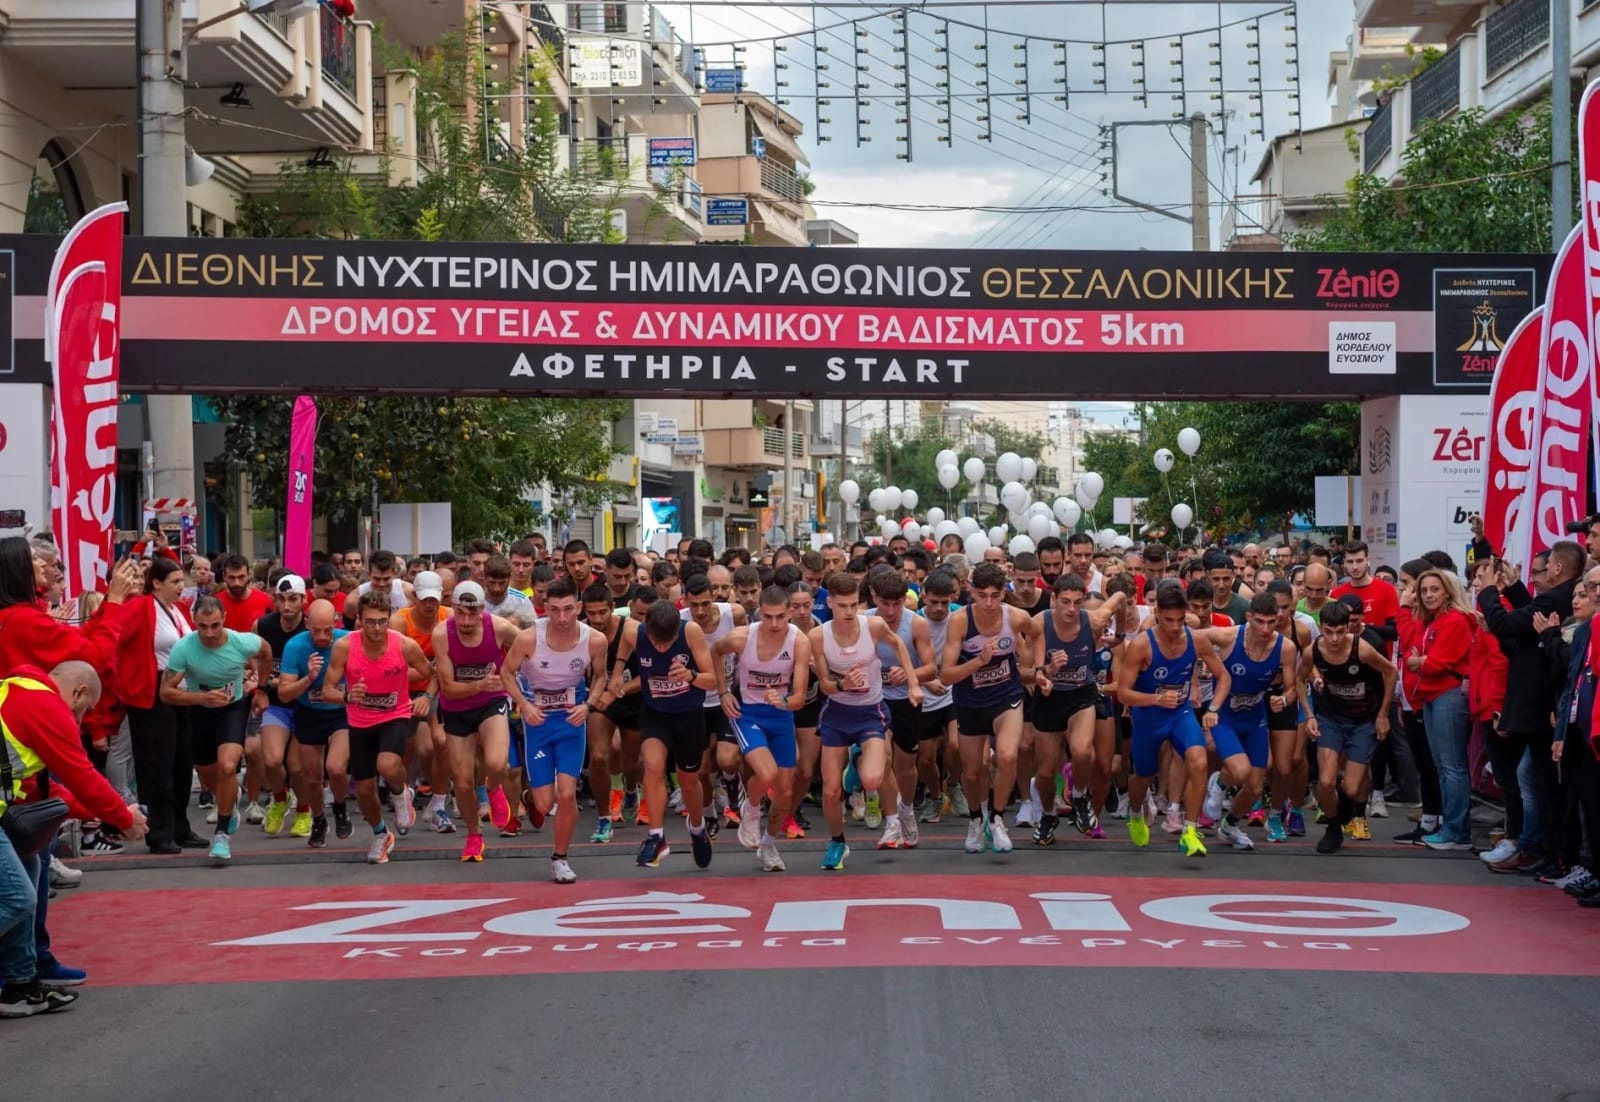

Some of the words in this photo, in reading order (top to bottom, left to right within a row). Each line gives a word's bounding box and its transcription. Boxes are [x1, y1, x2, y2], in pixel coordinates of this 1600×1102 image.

[131, 252, 324, 287] ΔΙΕΘΝΗΣ
[336, 255, 598, 293] ΝΥΧΤΕΡΙΝΟΣ
[609, 260, 971, 298] ΗΜΙΜΑΡΑΘΩΝΙΟΣ
[982, 267, 1295, 300] ΘΕΣΣΑΛΟΝΙΚΗΣ
[281, 306, 436, 336] ΔΡΟΜΟΣ
[450, 307, 580, 338] ΥΓΕΙΑΣ
[595, 310, 618, 339] &
[632, 311, 844, 342] ΔΥΝΑΜΙΚΟΥ
[858, 314, 1084, 346] ΒΑΔΙΣΜΑΤΟΣ
[1101, 313, 1184, 346] 5km
[1336, 332, 1372, 341] ΔΗΜΟΣ
[1336, 343, 1392, 352] ΚΟΡΔΕΛΙΟΥ
[1336, 354, 1385, 363] ΕΥΟΣΜΟΥ
[509, 352, 757, 380] ΑΦΕΤΗΡΙΑ
[784, 364, 797, 372] -
[825, 356, 970, 383] START
[541, 693, 569, 705] 51361
